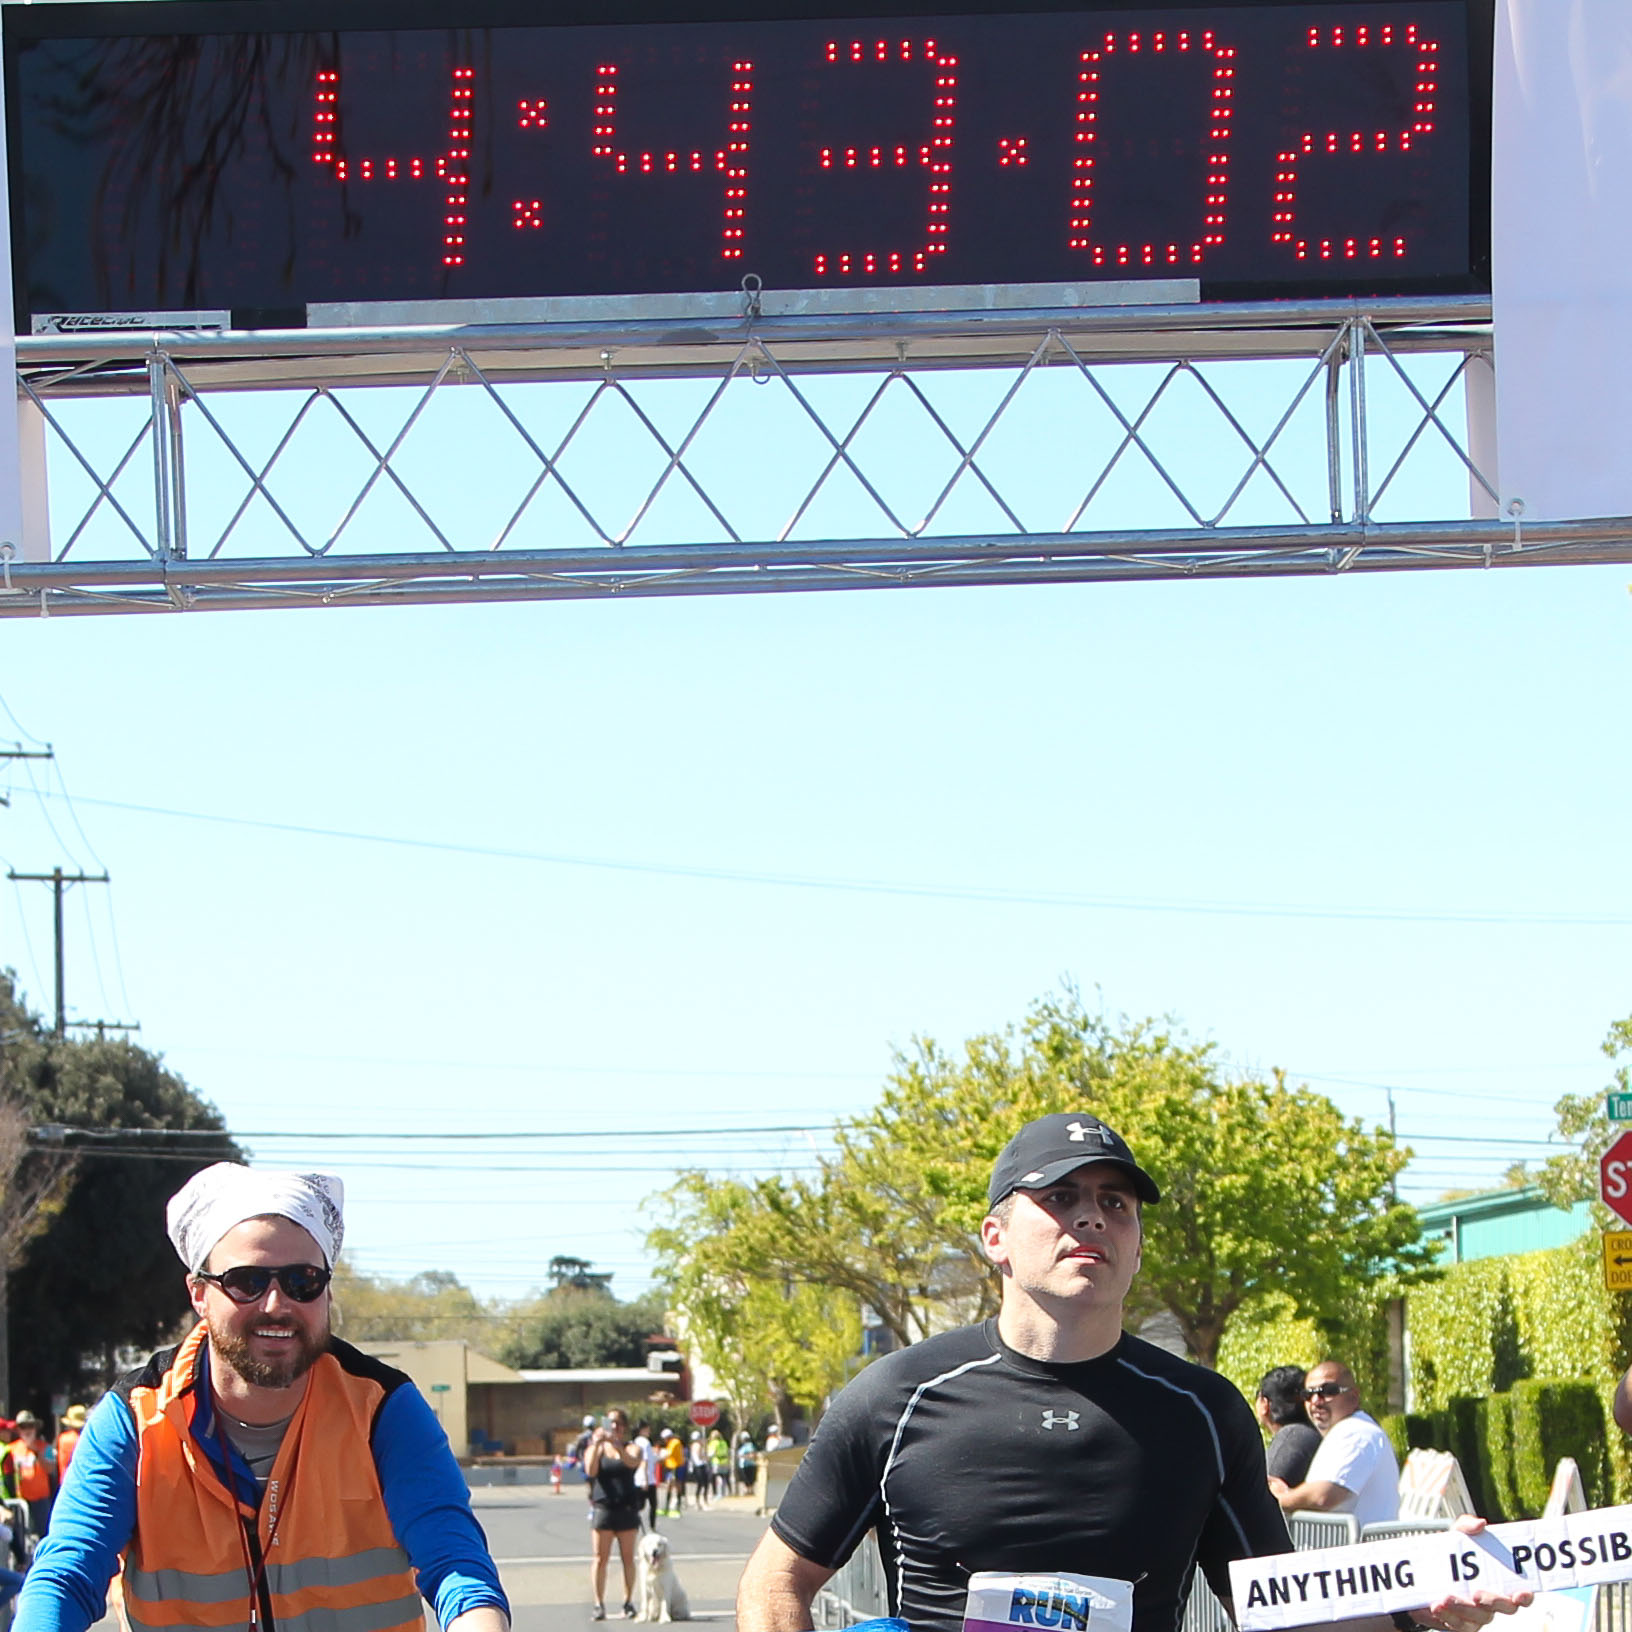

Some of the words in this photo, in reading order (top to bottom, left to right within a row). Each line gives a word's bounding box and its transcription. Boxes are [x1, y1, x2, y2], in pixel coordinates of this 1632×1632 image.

[1246, 1559, 1416, 1610] ANYTHING
[1450, 1550, 1482, 1583] IS
[1009, 1587, 1090, 1632] RUN
